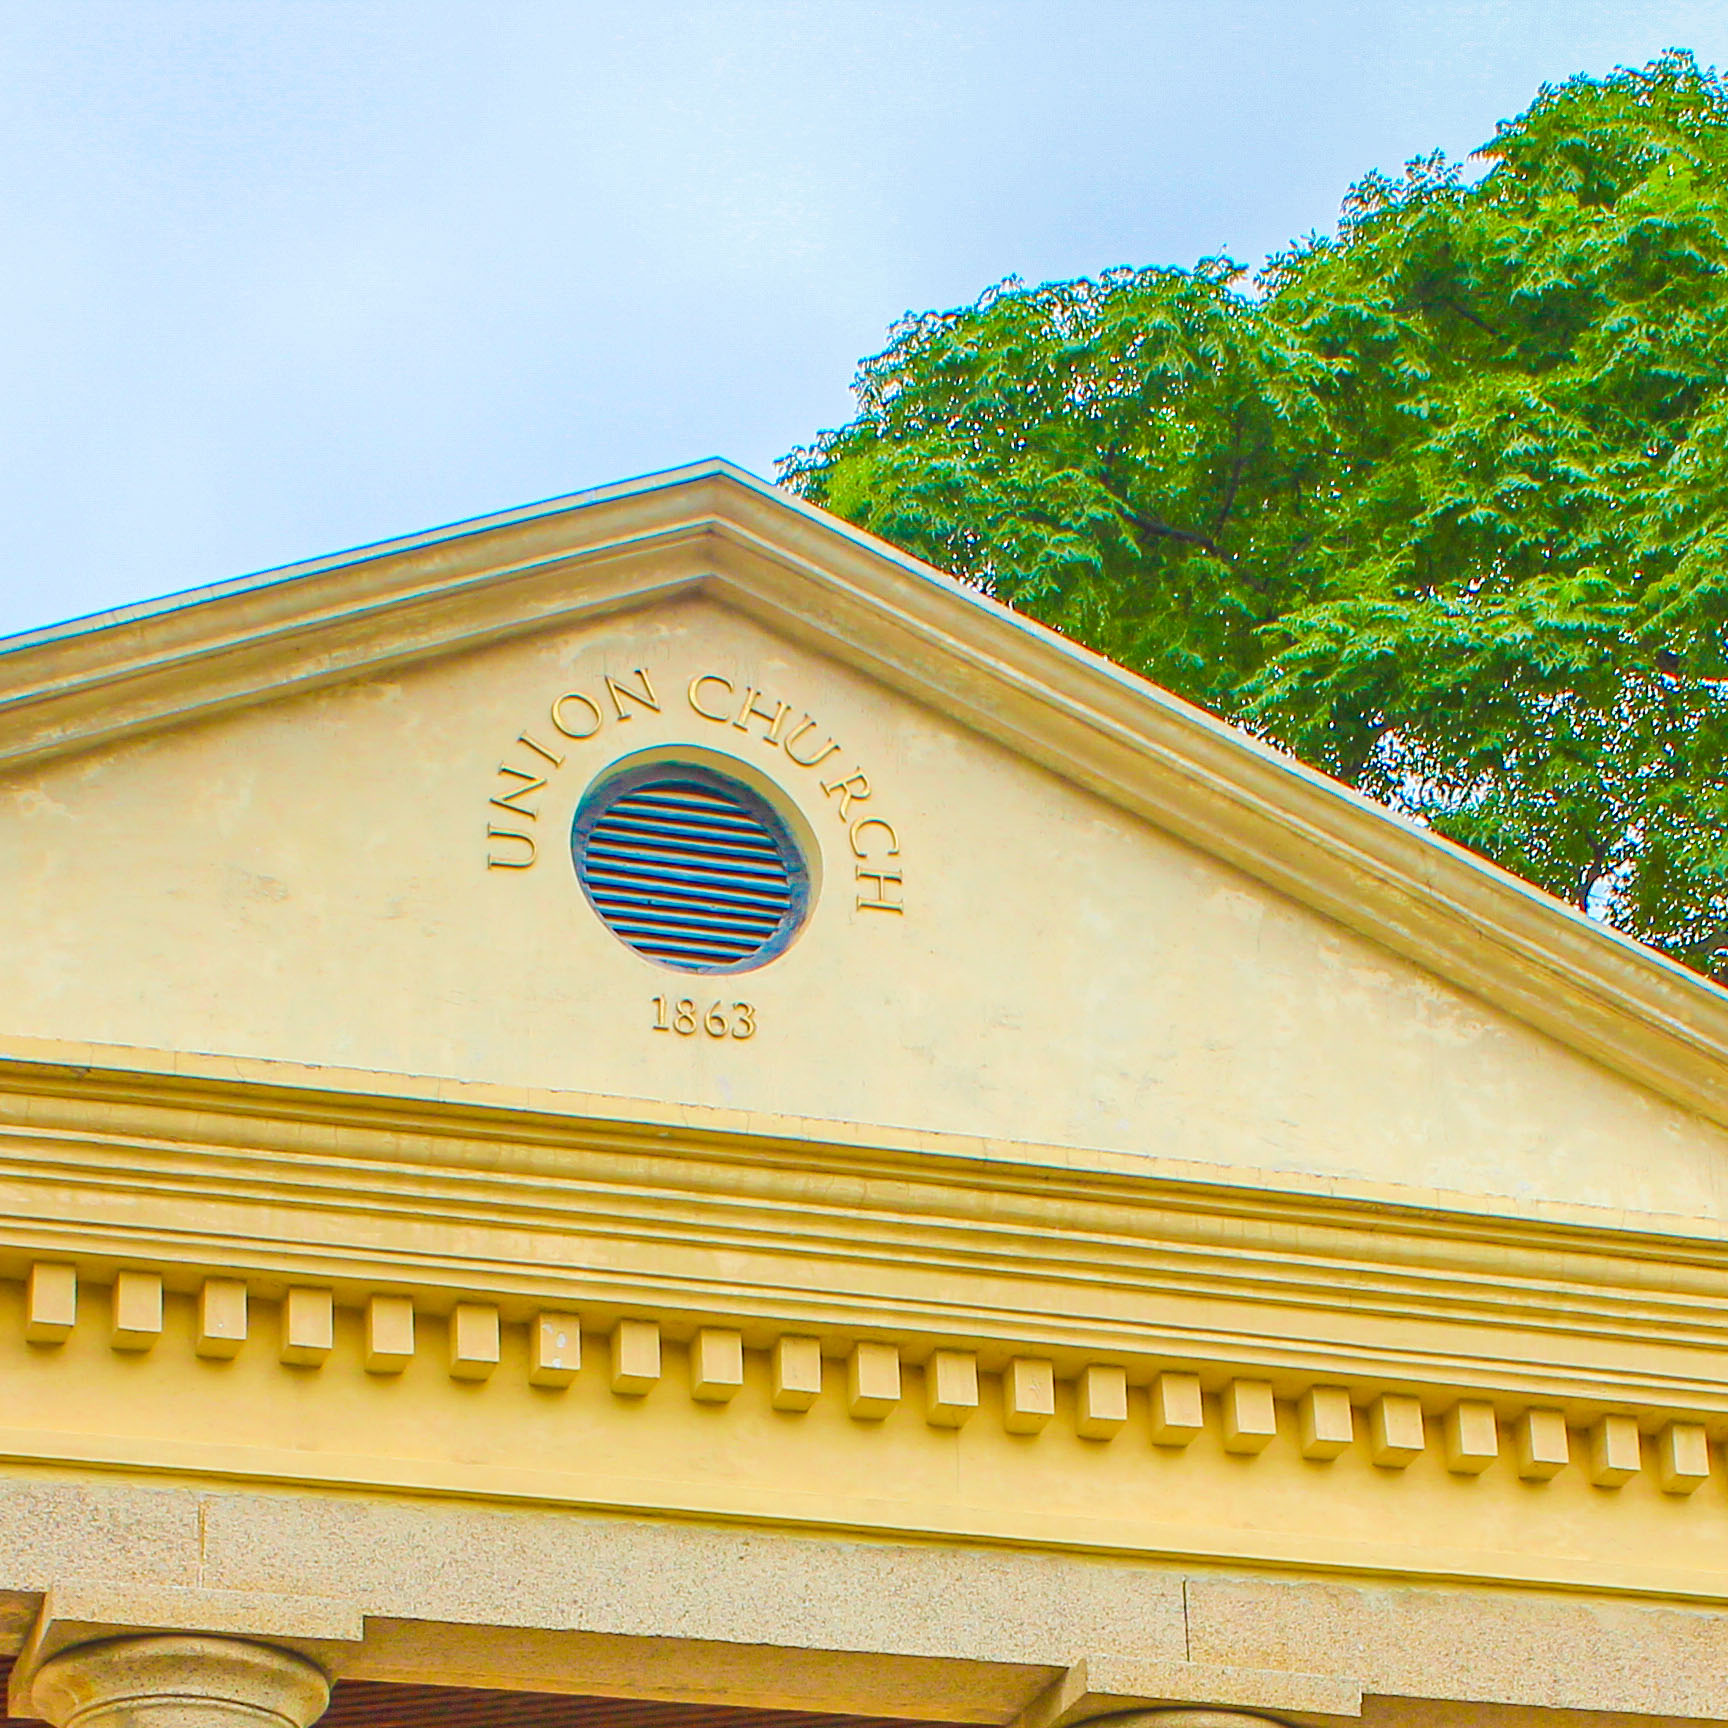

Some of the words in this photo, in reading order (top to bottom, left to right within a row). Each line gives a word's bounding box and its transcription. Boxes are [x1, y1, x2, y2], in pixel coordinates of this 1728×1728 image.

[487, 668, 661, 870] UNION
[687, 674, 904, 916] CHURCH
[650, 993, 757, 1039] 1863
